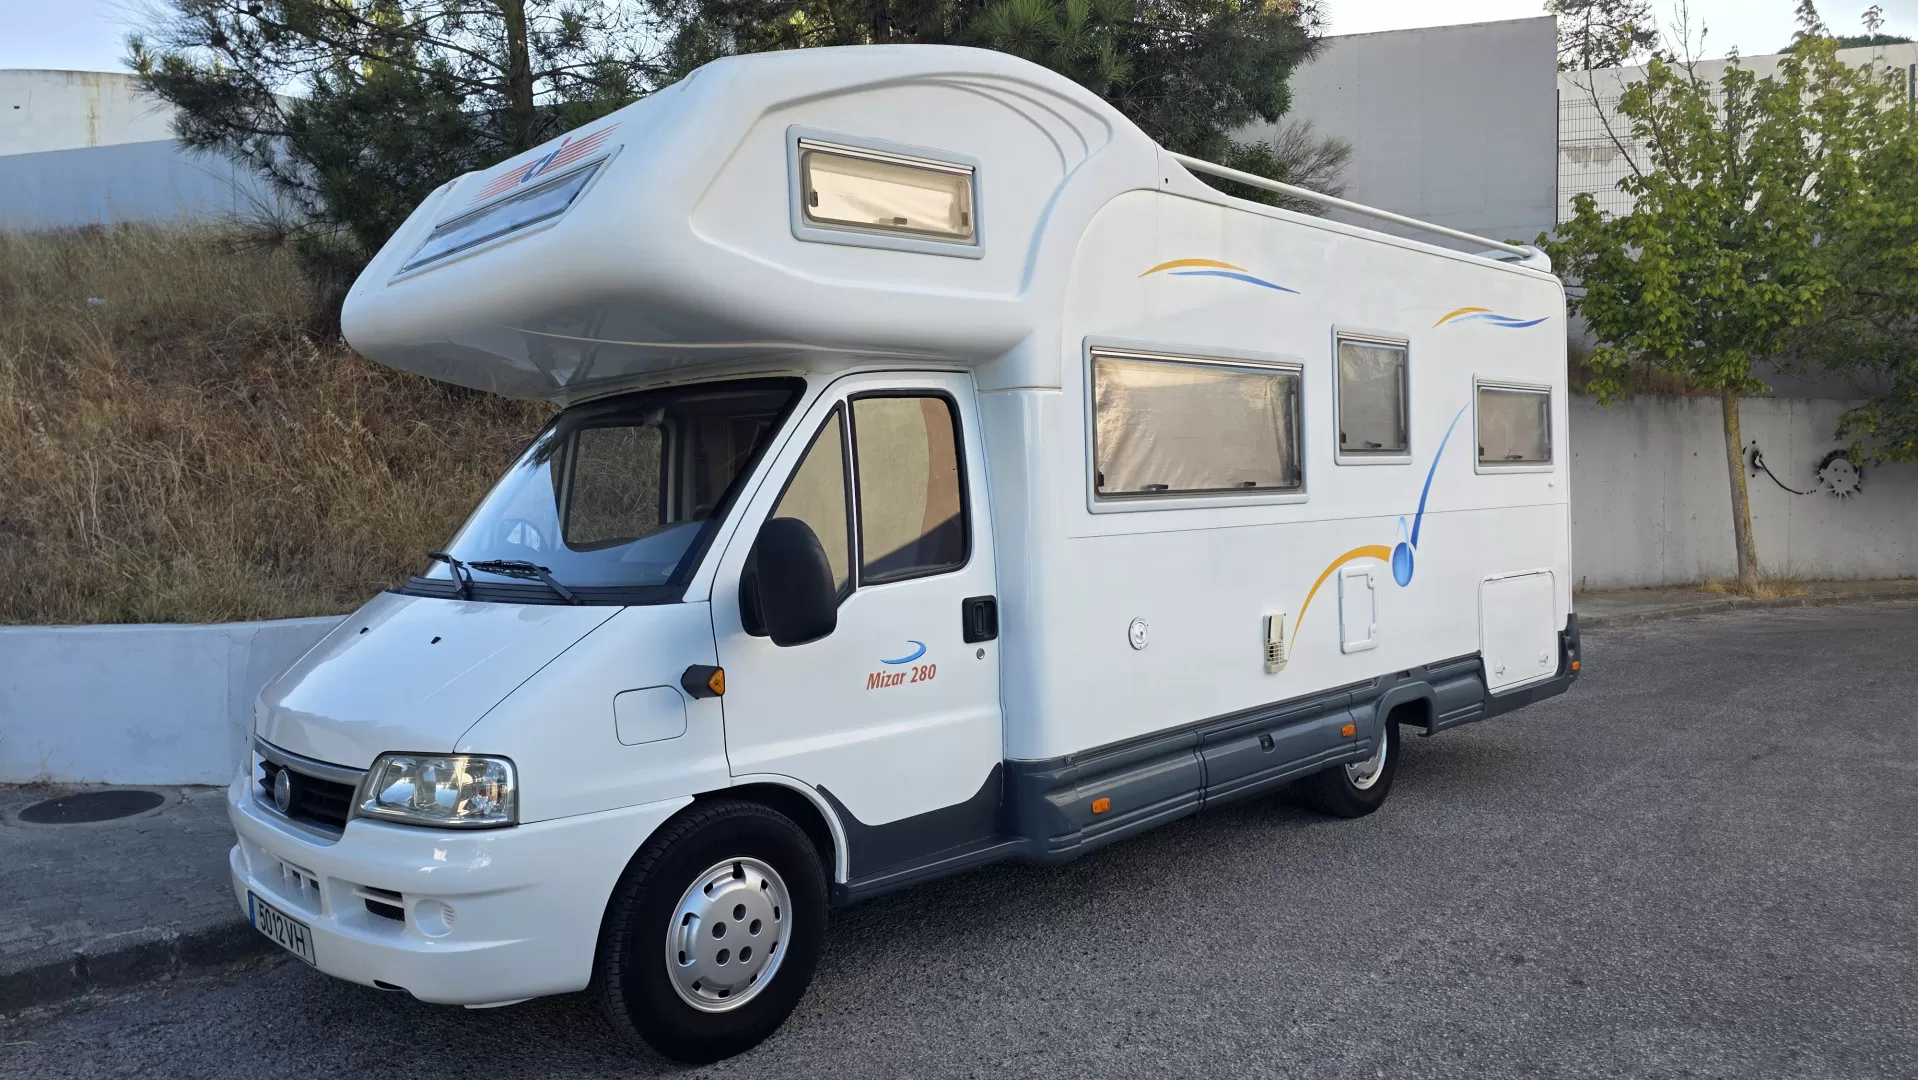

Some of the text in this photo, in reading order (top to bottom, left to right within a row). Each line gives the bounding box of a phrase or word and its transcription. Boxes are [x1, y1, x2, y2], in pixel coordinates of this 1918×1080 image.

[866, 663, 937, 690] Mizar 280
[258, 902, 306, 956] 5012VH
